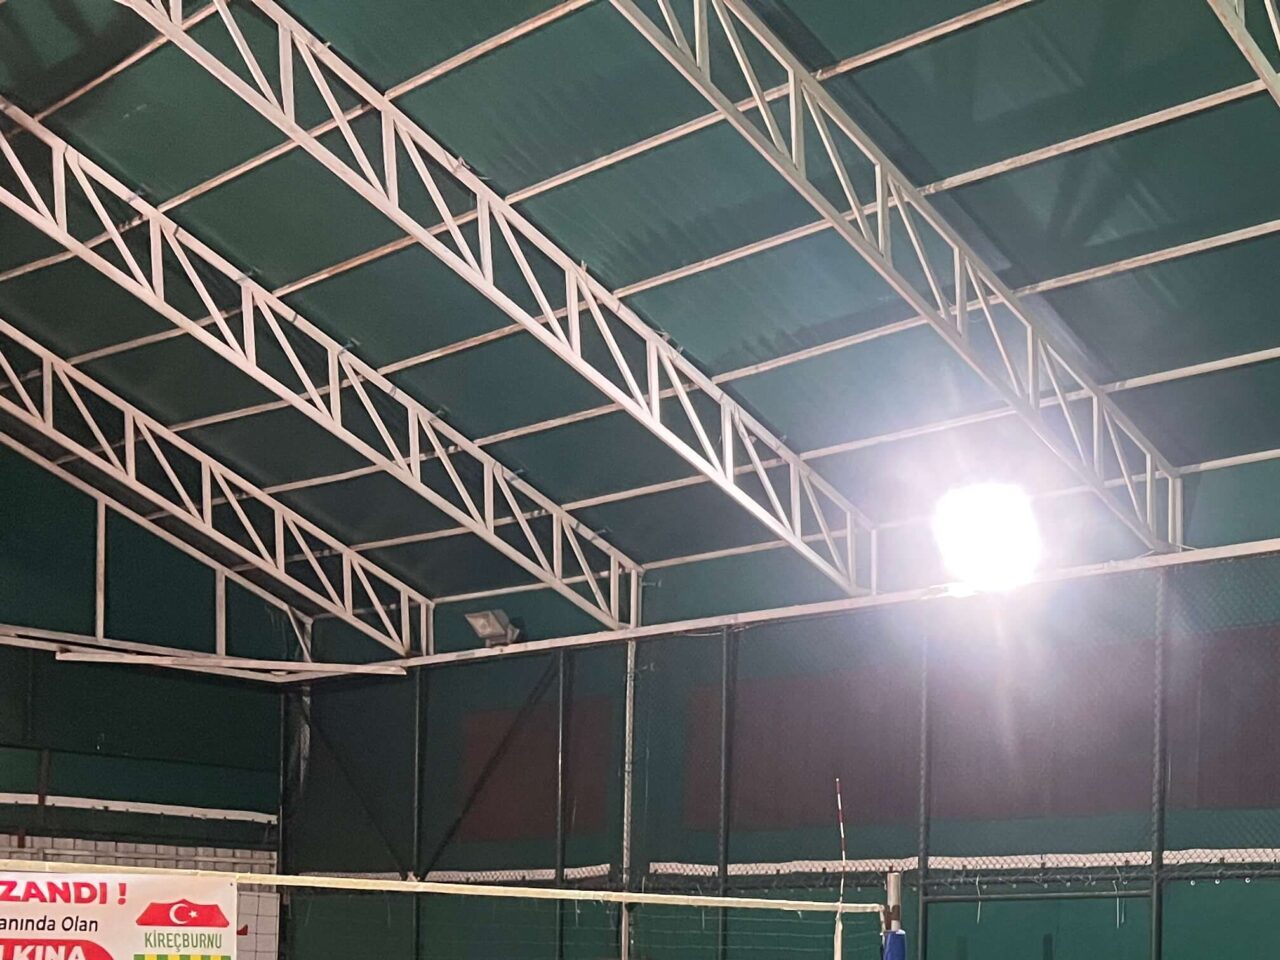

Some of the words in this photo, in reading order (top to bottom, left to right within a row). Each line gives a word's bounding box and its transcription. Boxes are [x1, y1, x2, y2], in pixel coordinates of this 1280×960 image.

[0, 915, 56, 931] anında
[61, 915, 98, 932] Olan
[144, 930, 223, 953] KİREÇBURNU
